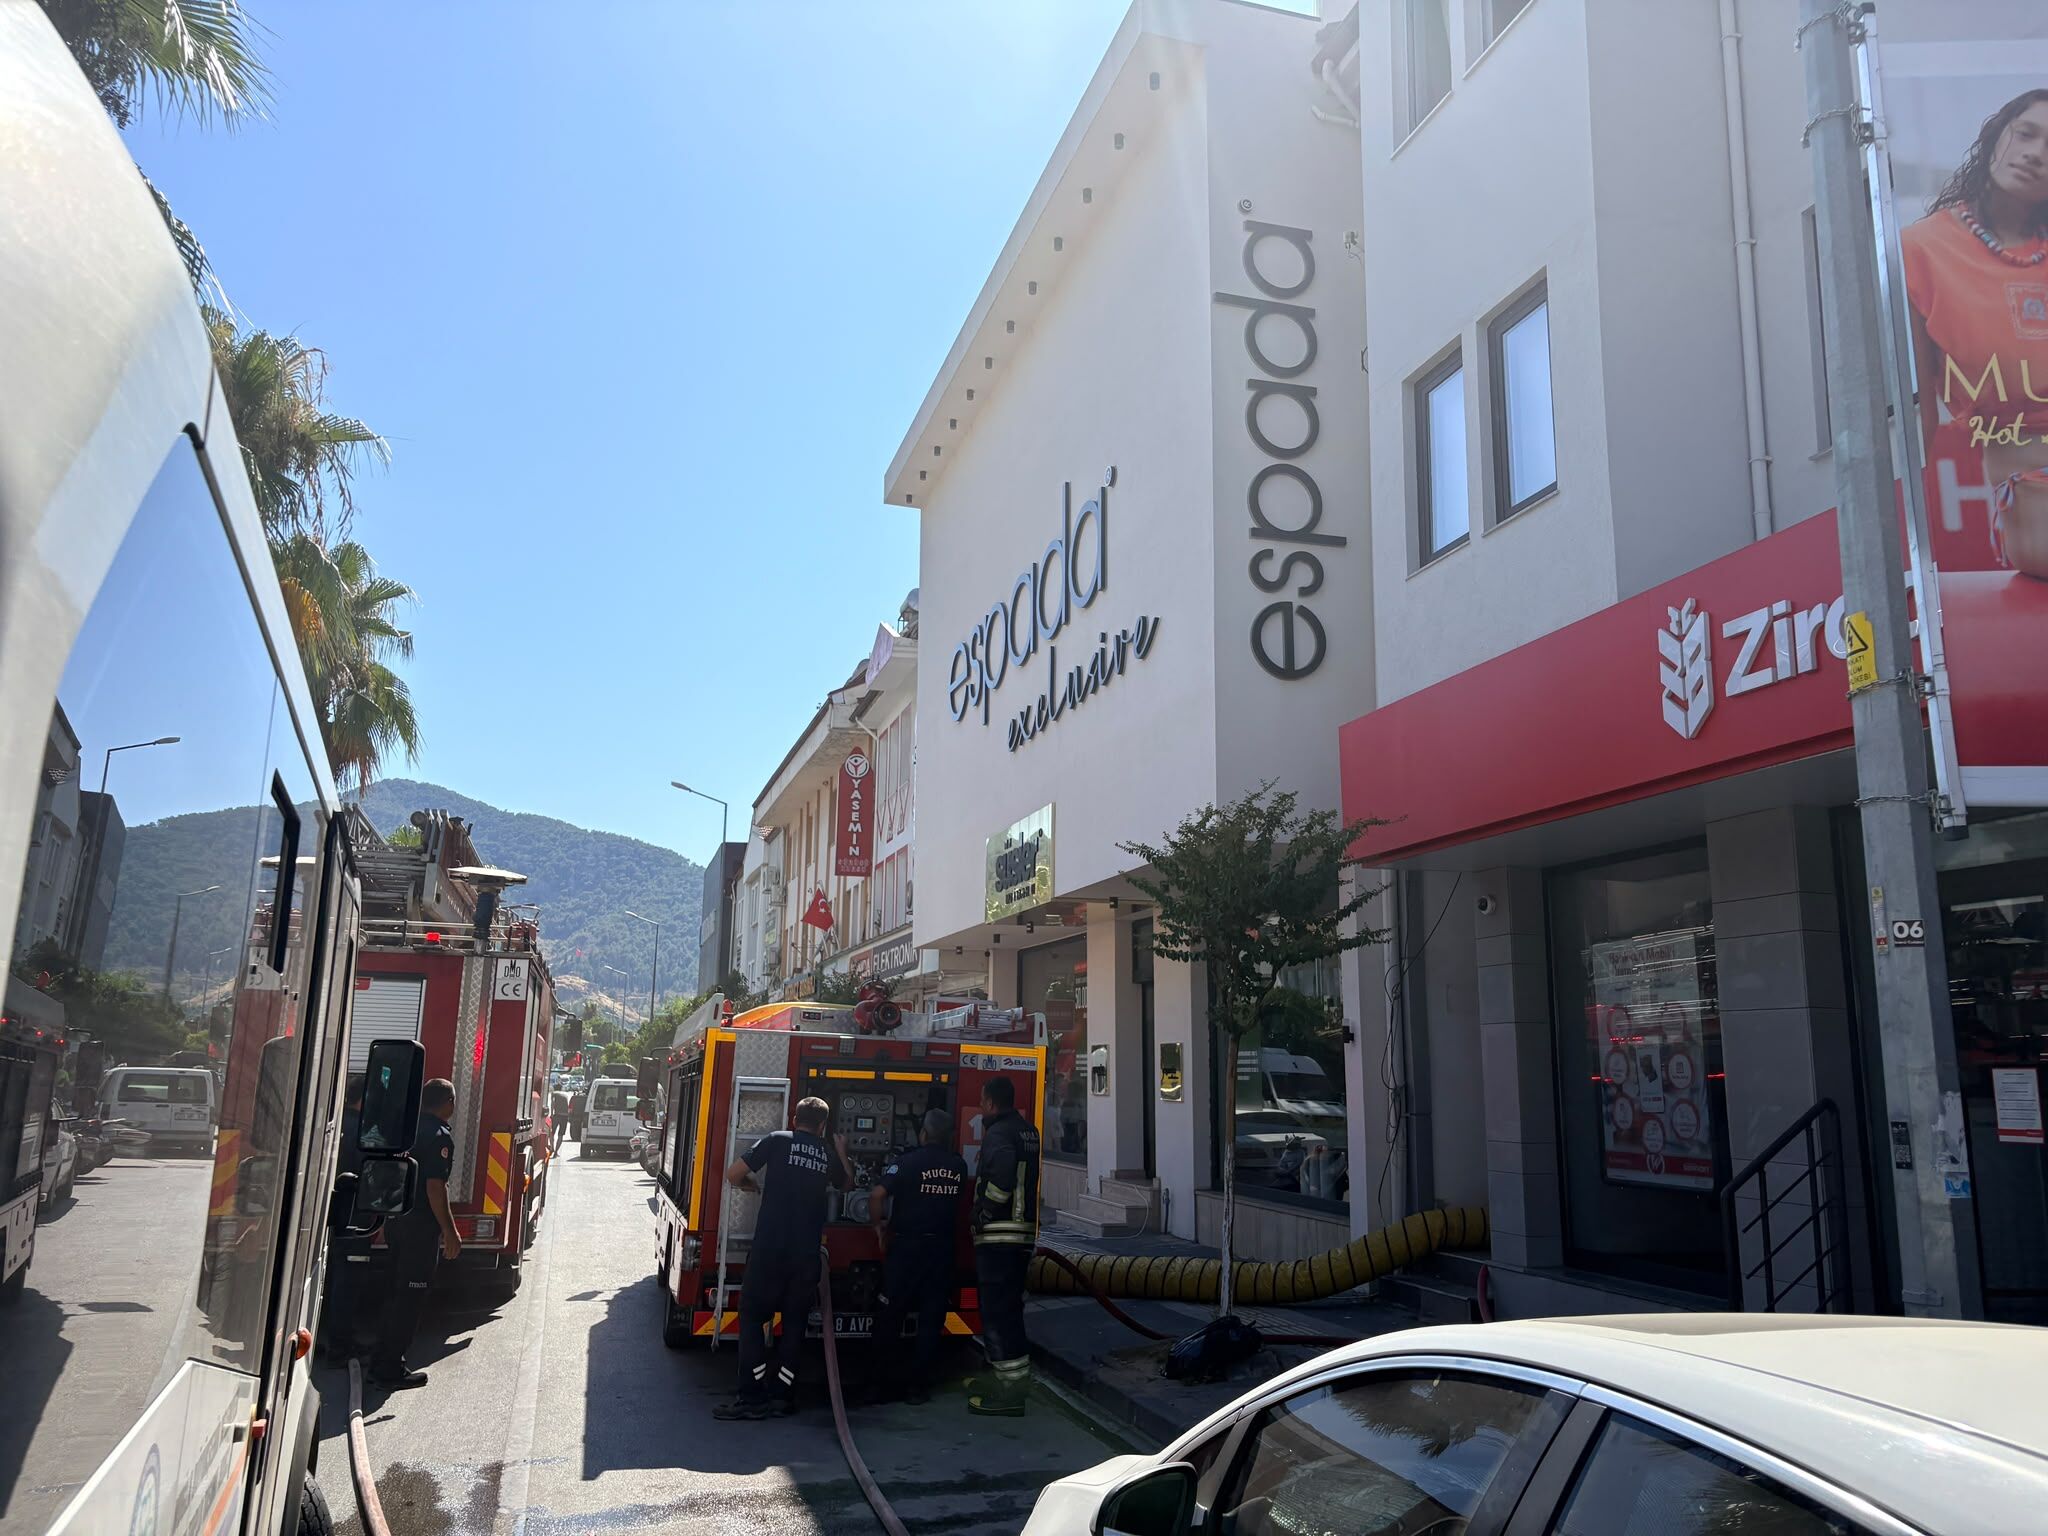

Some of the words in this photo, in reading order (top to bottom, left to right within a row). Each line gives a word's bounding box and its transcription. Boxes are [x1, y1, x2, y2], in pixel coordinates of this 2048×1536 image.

[1968, 412, 2033, 448] Hot
[1893, 920, 1924, 939] 06
[501, 982, 522, 997] CE
